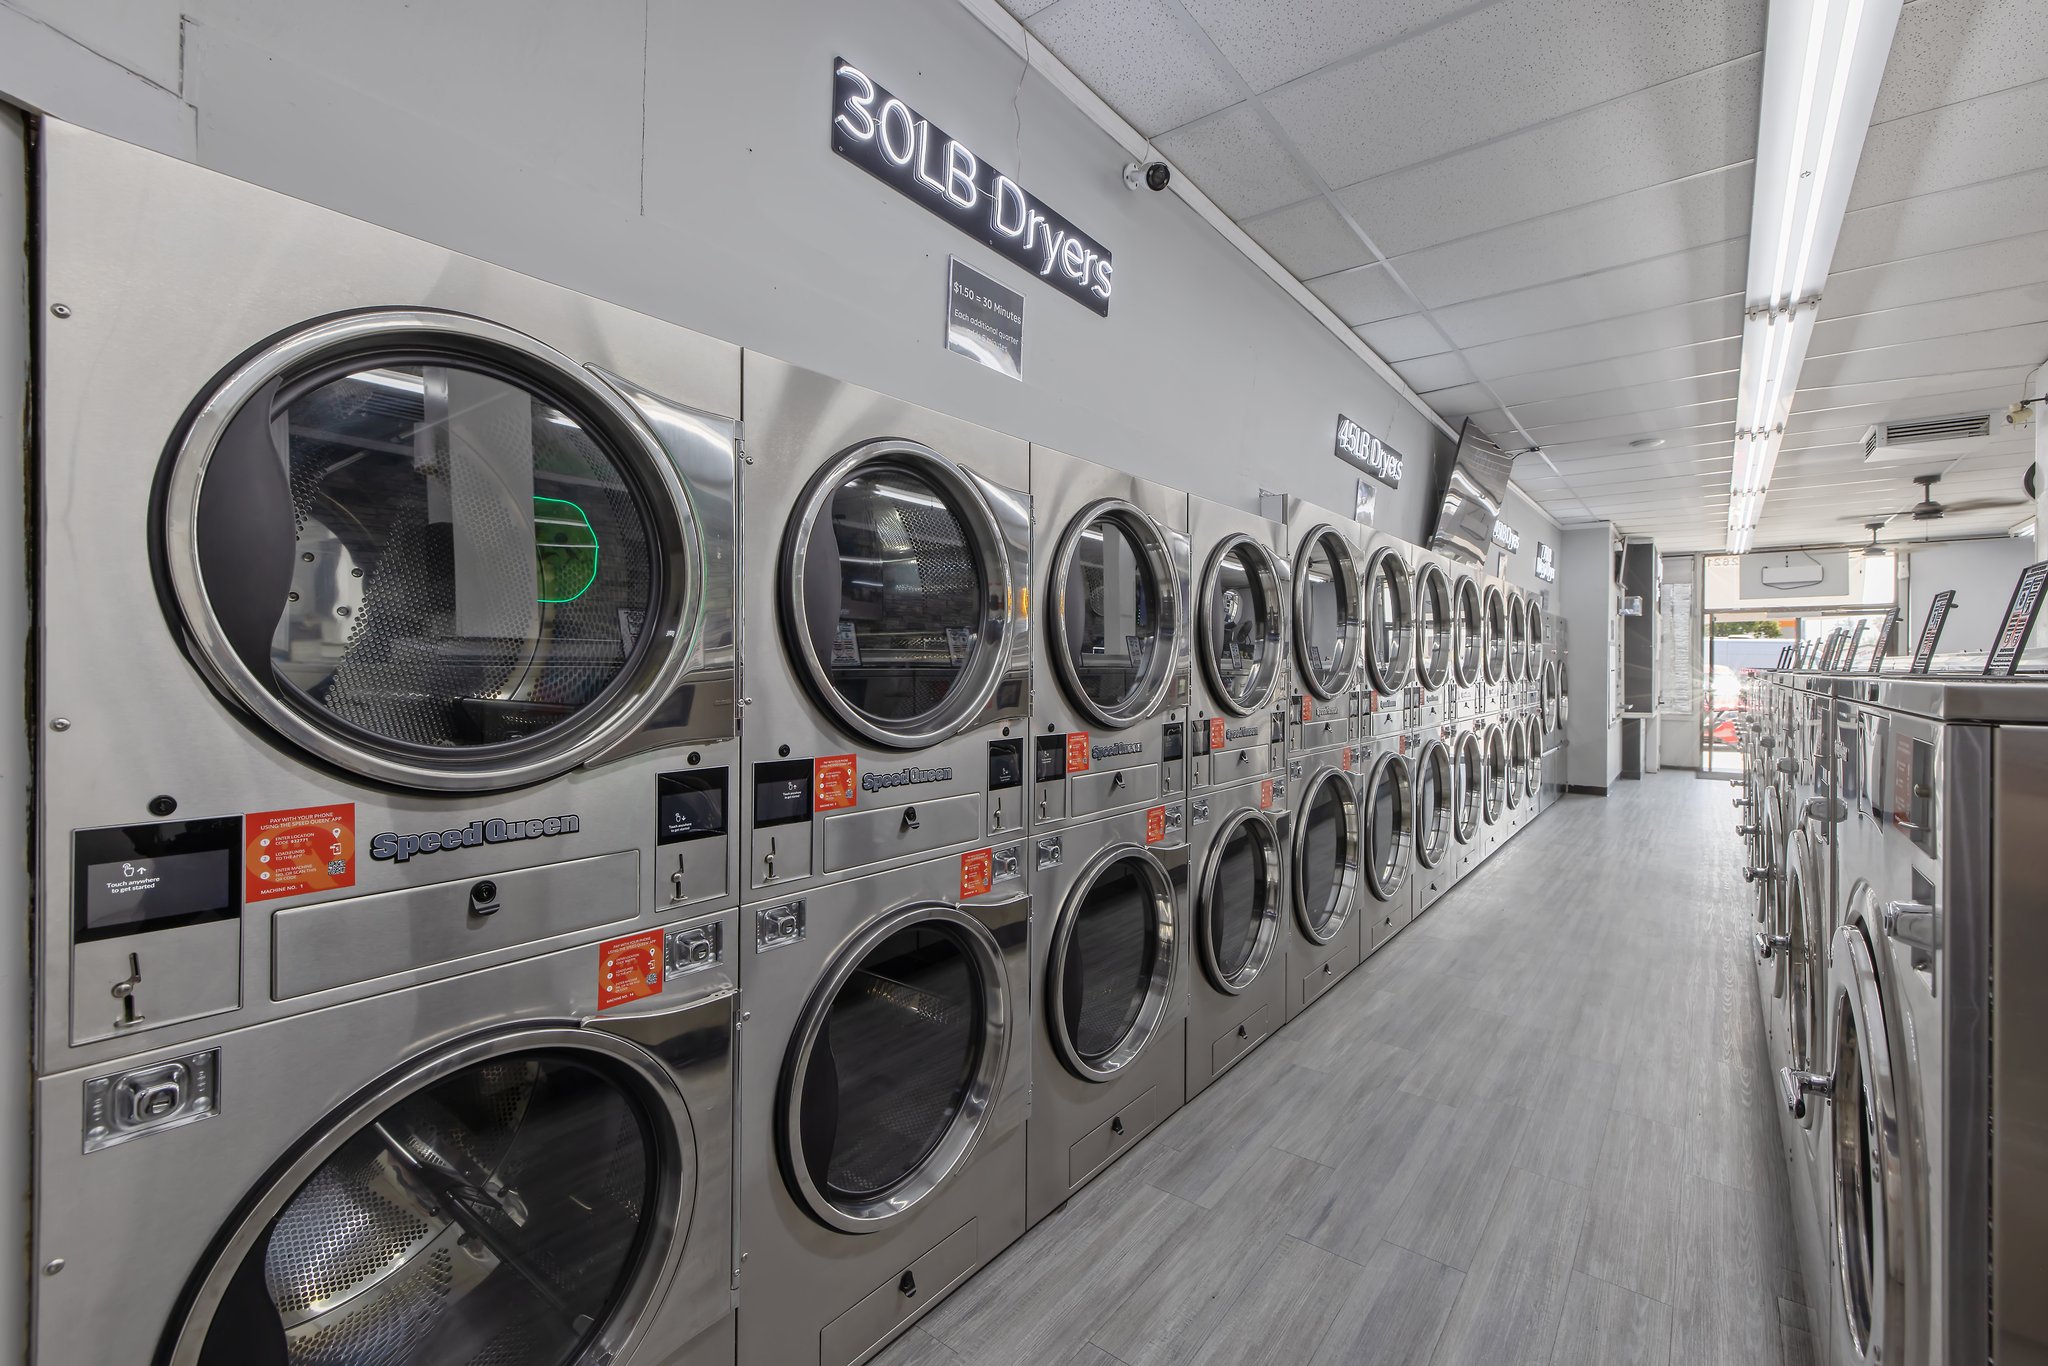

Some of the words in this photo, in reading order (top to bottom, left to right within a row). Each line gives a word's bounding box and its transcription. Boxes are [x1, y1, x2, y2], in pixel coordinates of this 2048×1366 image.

[834, 65, 978, 209] 30LB
[990, 175, 1113, 298] Dryers
[954, 282, 974, 300] $1.50
[982, 296, 992, 309] 30
[994, 302, 1022, 324] Minutes
[954, 308, 970, 322] Each
[970, 315, 998, 335] additional
[999, 330, 1018, 346] quarter
[1338, 419, 1370, 460] 45LB
[1368, 438, 1403, 480] Dryers
[862, 768, 910, 793] Speed
[910, 767, 952, 784] Queen
[291, 832, 314, 840] LOCATION
[370, 821, 484, 864] Speed
[484, 814, 580, 844] Queen
[128, 877, 160, 886] anywhere
[132, 883, 155, 891] started
[260, 886, 286, 894] MACHINE
